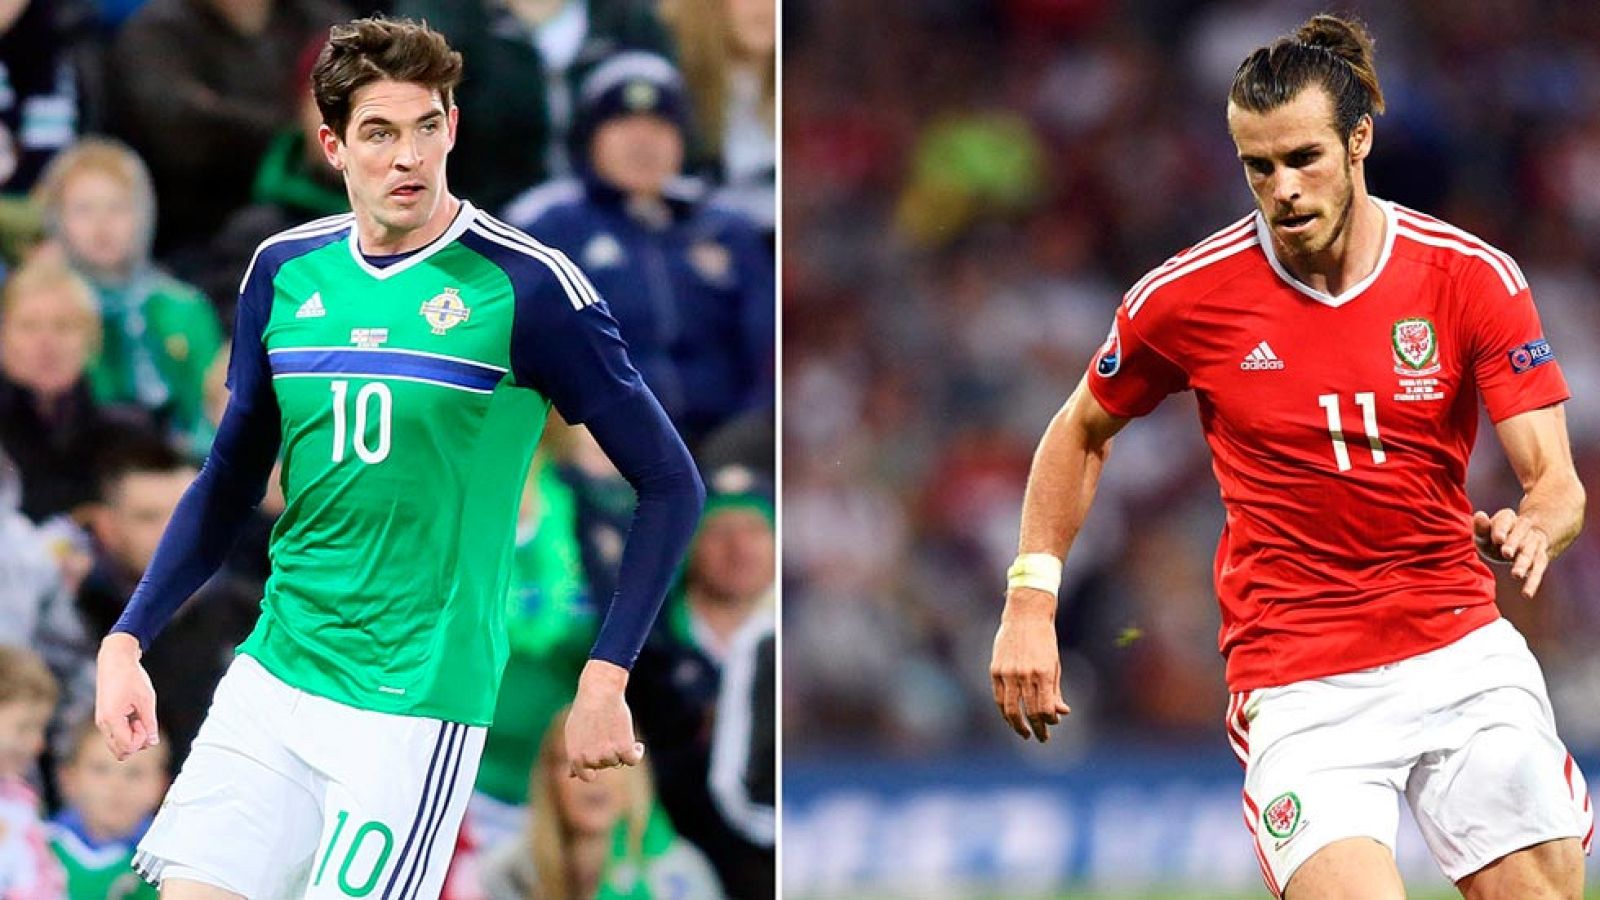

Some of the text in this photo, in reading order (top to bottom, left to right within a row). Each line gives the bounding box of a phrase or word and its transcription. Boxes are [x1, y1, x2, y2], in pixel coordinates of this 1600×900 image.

[1241, 359, 1285, 370] adidas
[331, 380, 393, 463] 10
[1318, 392, 1387, 472] 11
[314, 811, 394, 897] 10
